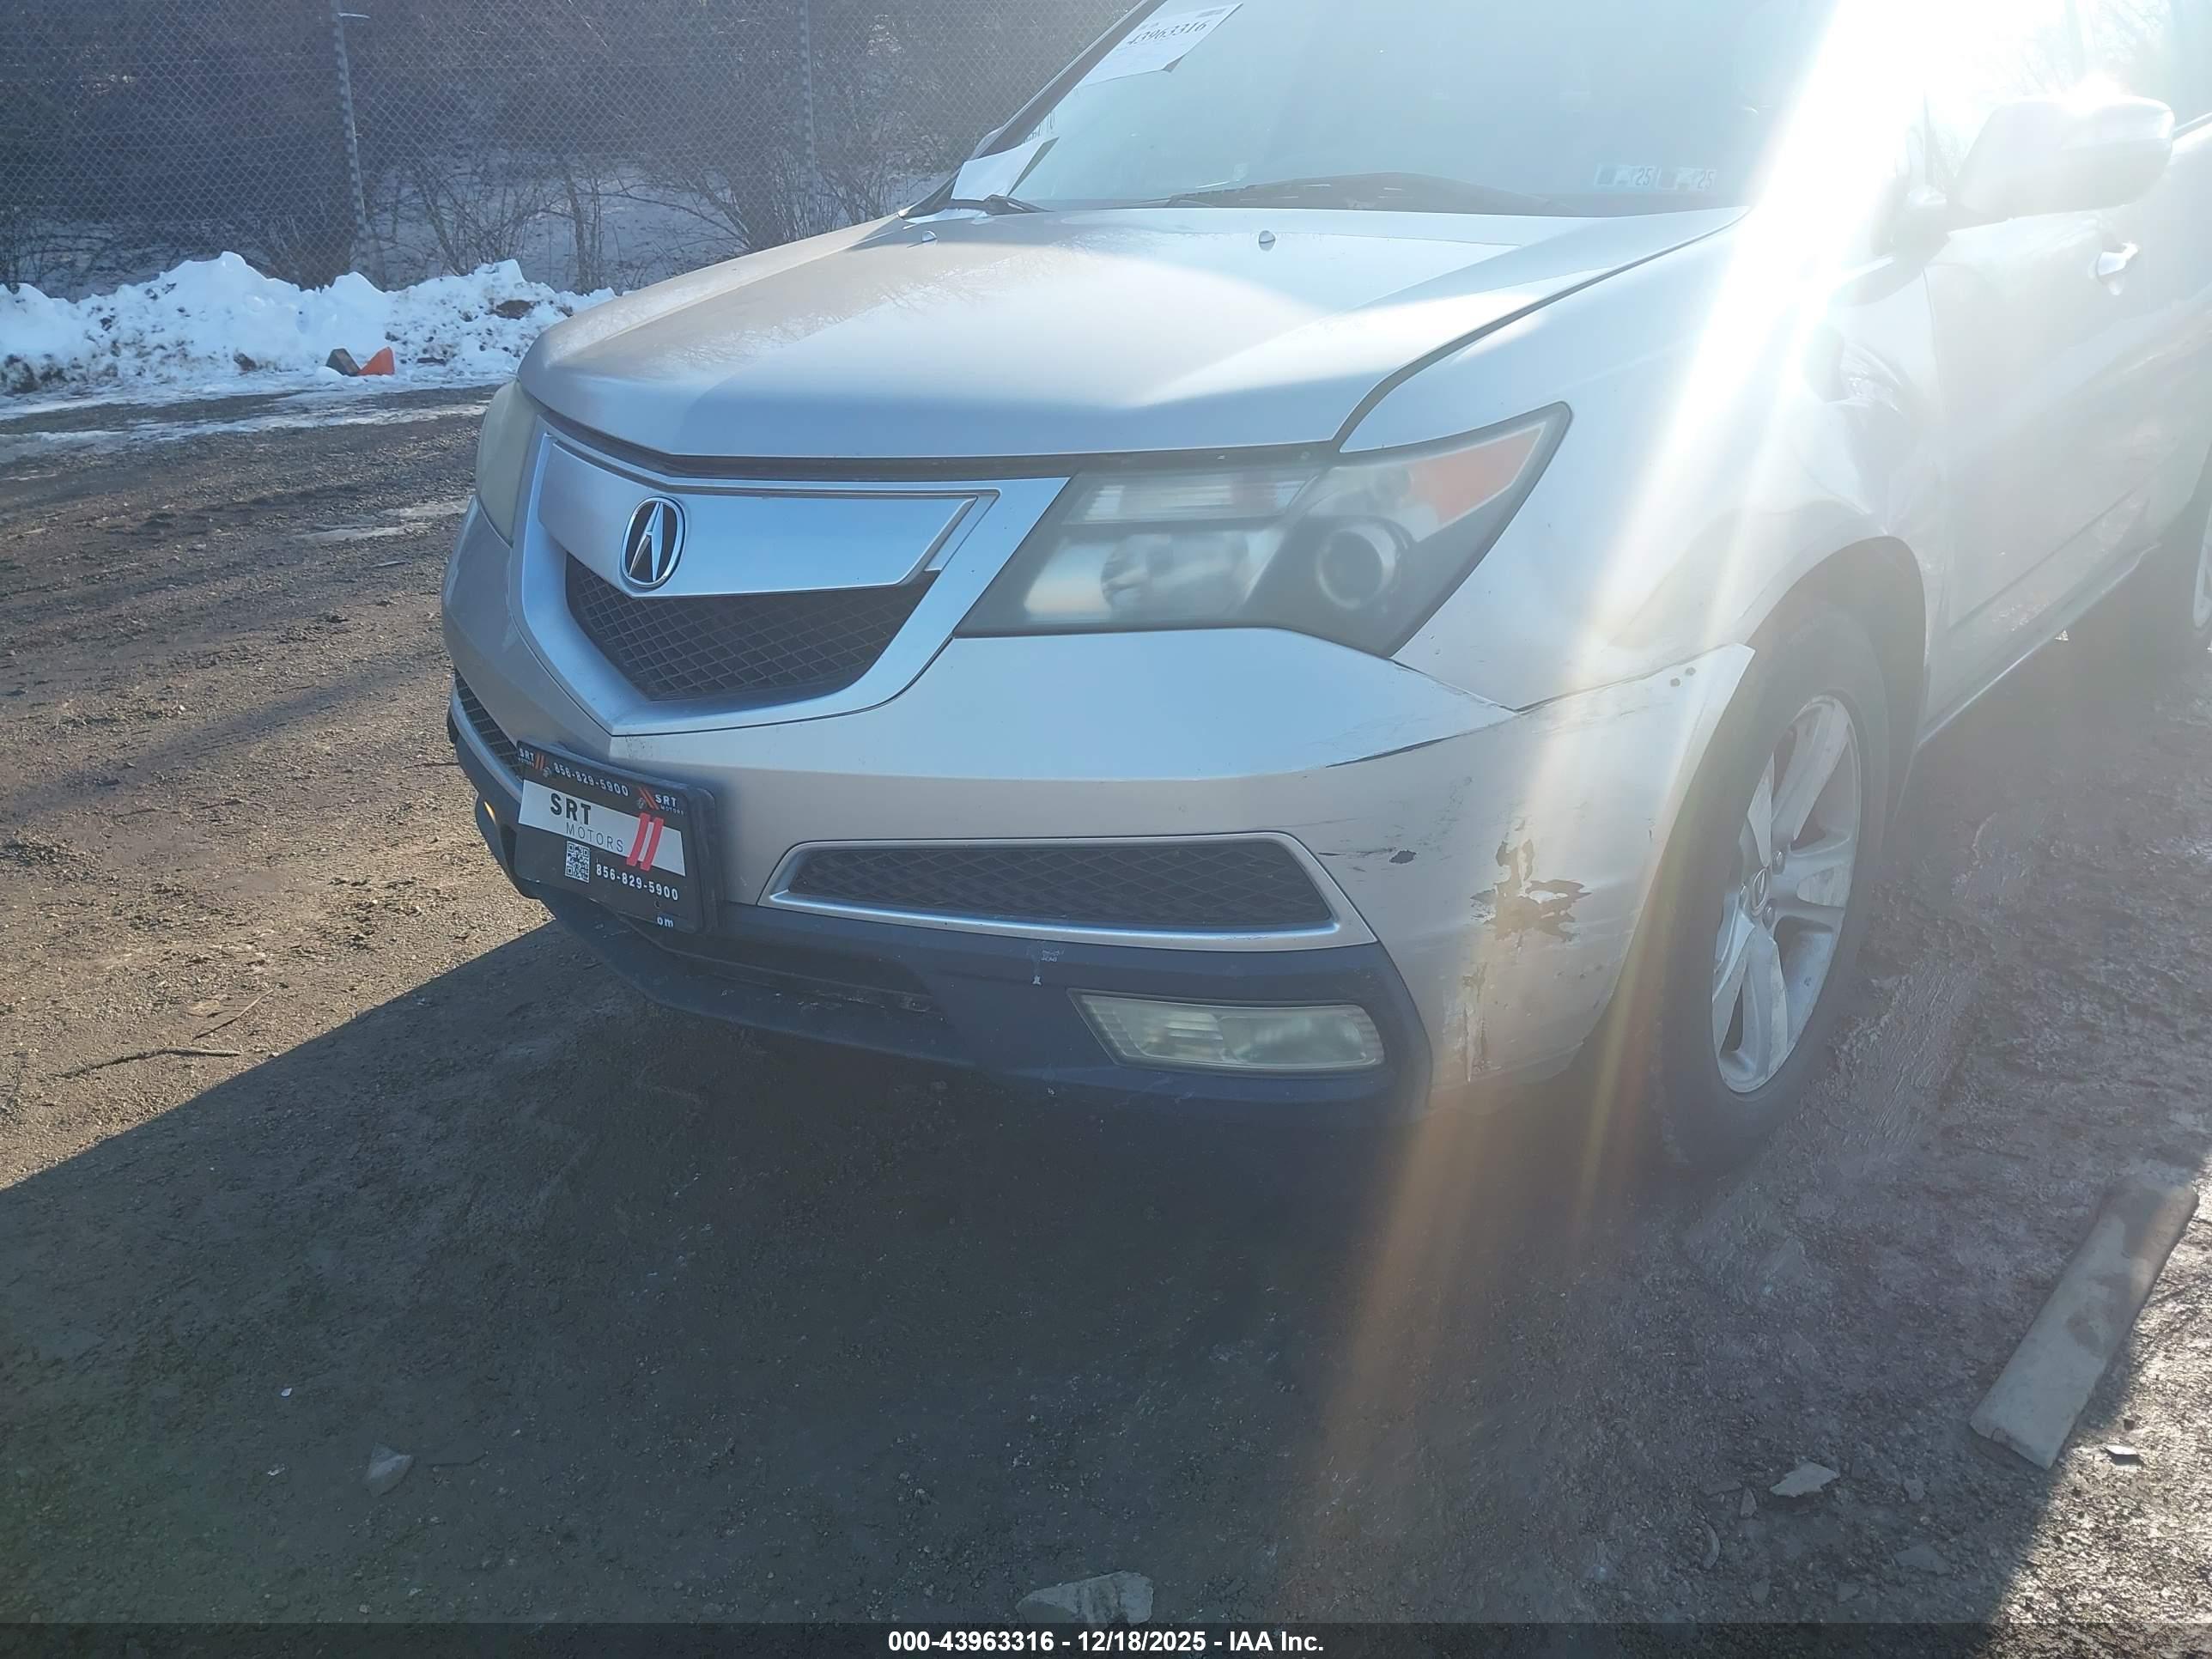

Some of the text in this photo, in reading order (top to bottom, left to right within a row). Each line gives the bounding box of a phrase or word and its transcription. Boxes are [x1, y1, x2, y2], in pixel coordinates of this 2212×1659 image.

[519, 748, 535, 762] SRT
[553, 762, 629, 797] 856-829-5900
[550, 793, 592, 825] SRT
[654, 793, 678, 807] SRT
[566, 822, 624, 853] MOTORS
[596, 864, 678, 901] 856-829-5900
